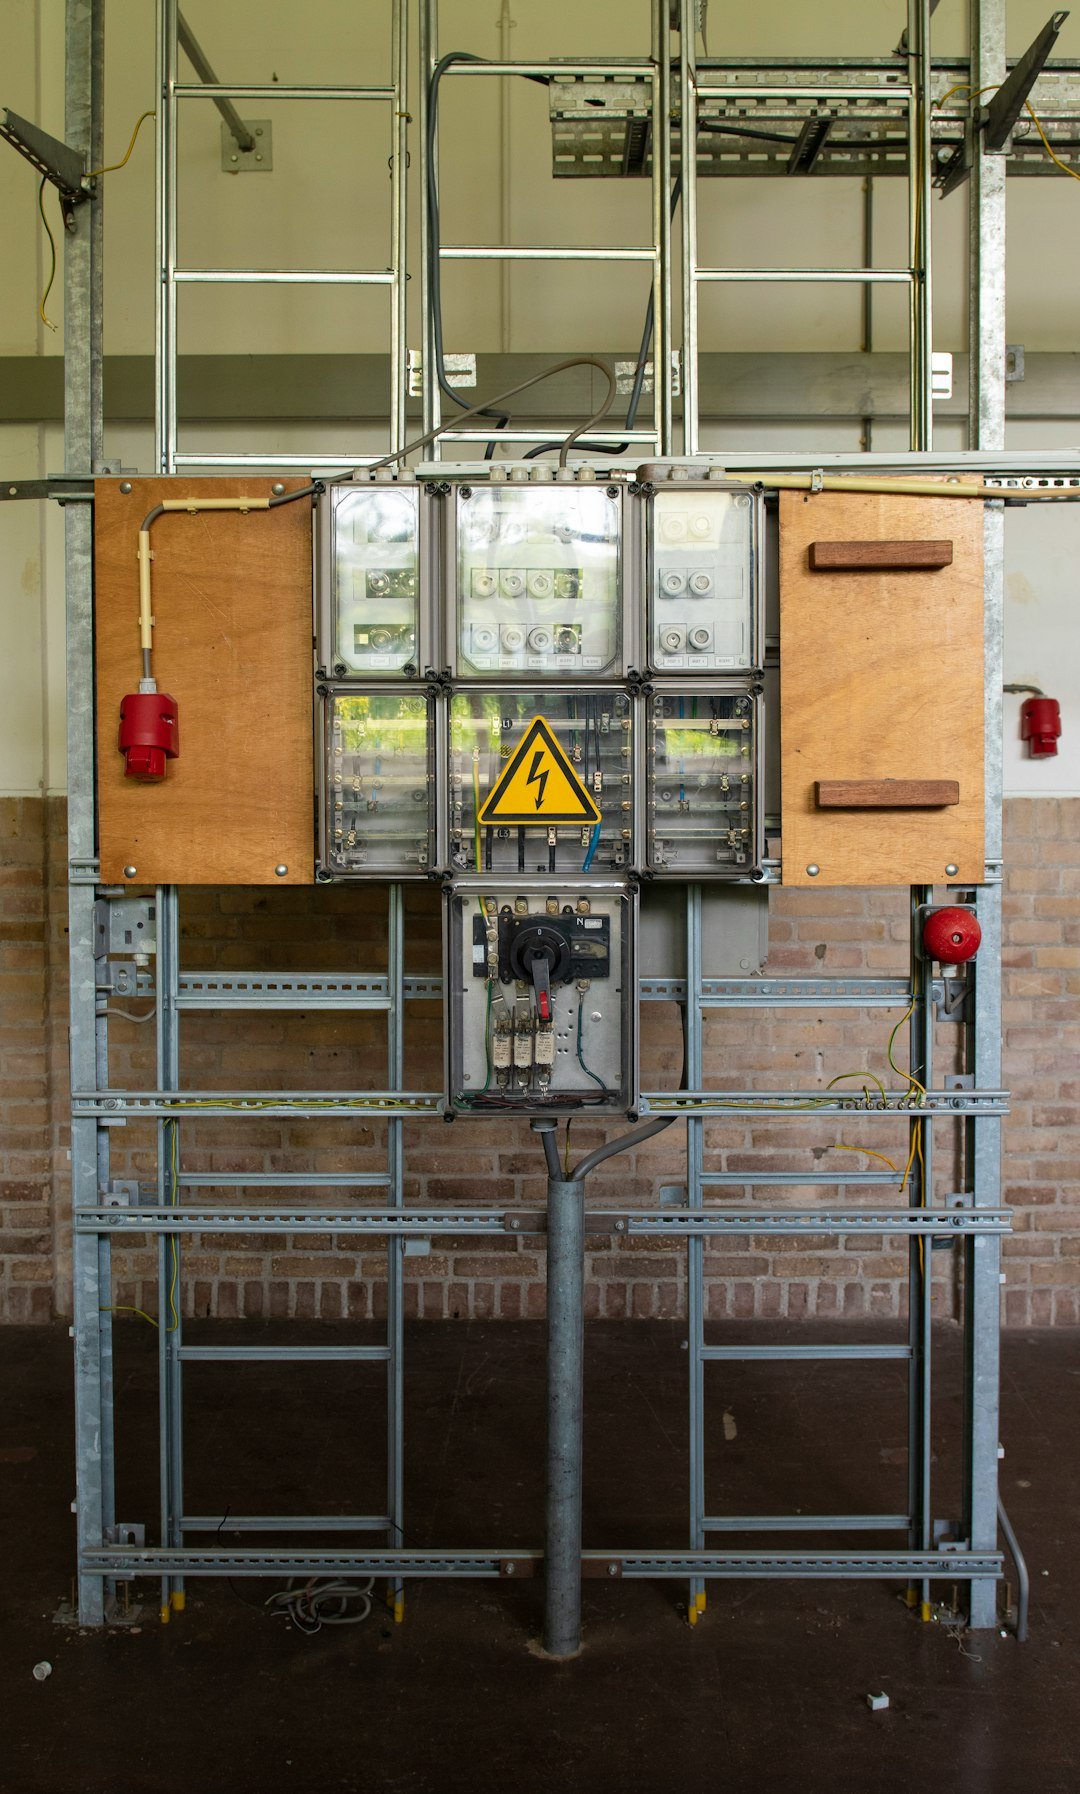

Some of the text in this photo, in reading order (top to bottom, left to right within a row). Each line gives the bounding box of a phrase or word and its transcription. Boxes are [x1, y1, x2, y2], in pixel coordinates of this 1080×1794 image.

[503, 720, 510, 728] L1
[499, 830, 509, 838] L3
[576, 917, 584, 926] N
